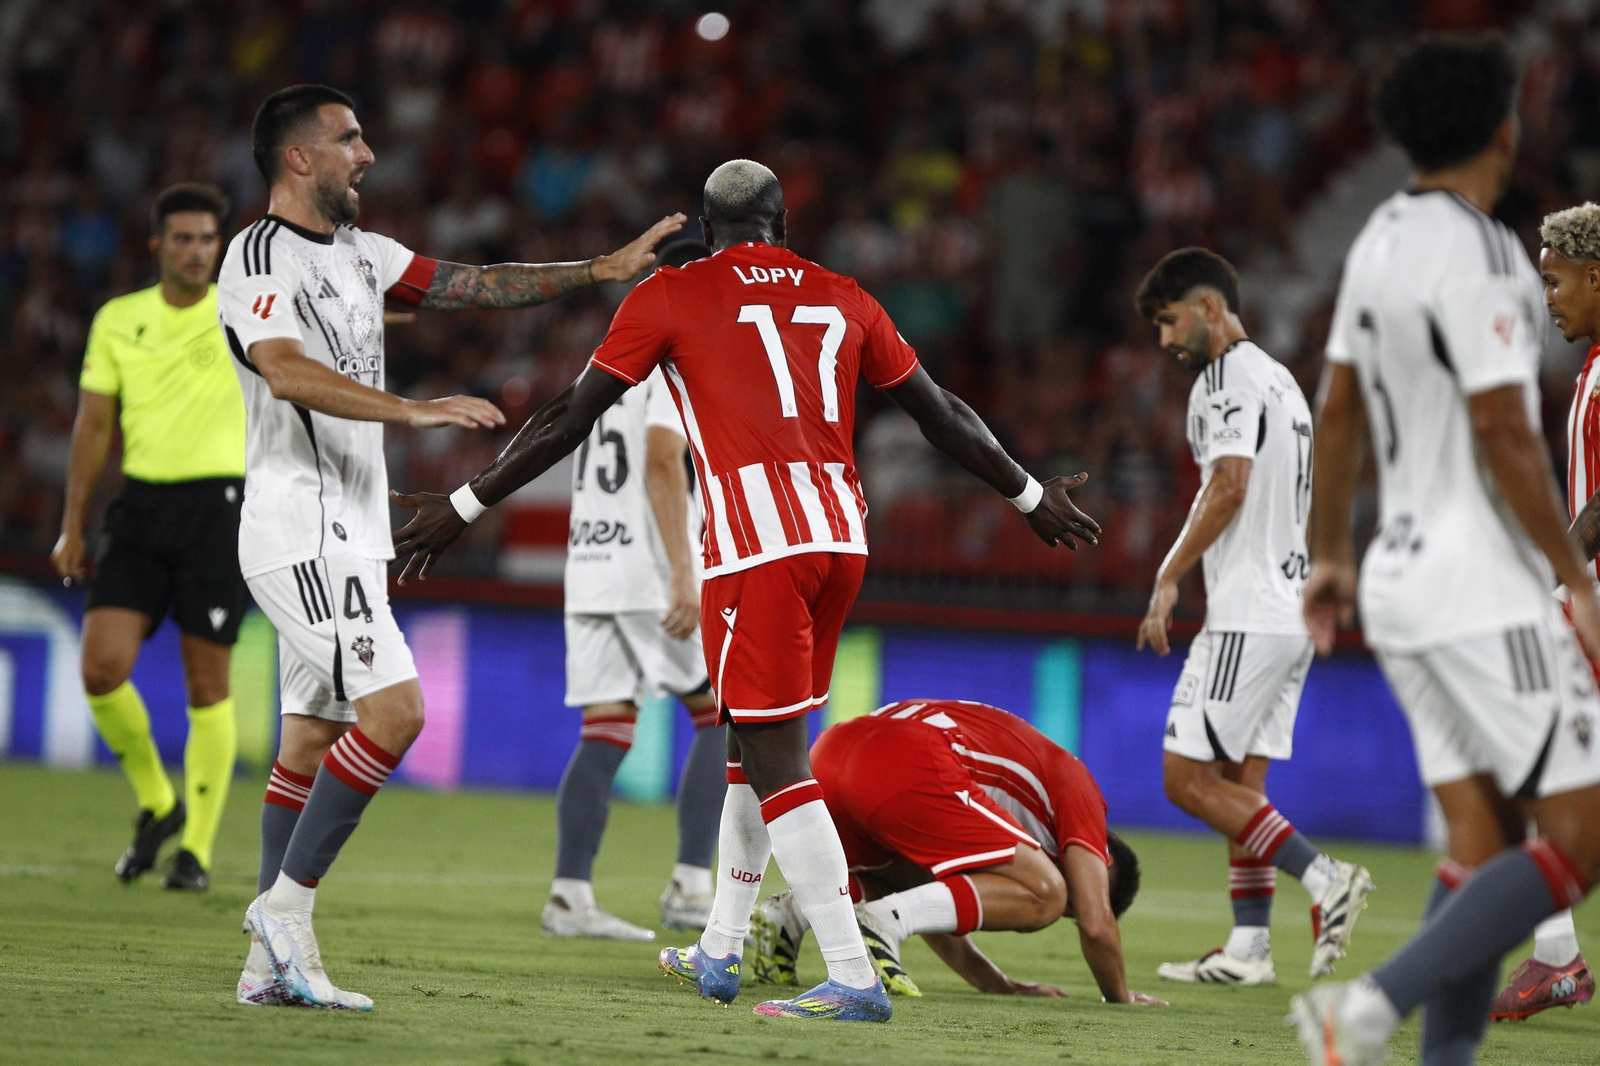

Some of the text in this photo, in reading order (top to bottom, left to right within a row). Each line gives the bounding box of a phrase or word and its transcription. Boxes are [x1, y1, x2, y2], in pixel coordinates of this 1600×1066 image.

[732, 265, 804, 286] LOPY
[736, 304, 847, 423] 17
[343, 575, 370, 619] 4
[731, 867, 762, 883] UDA
